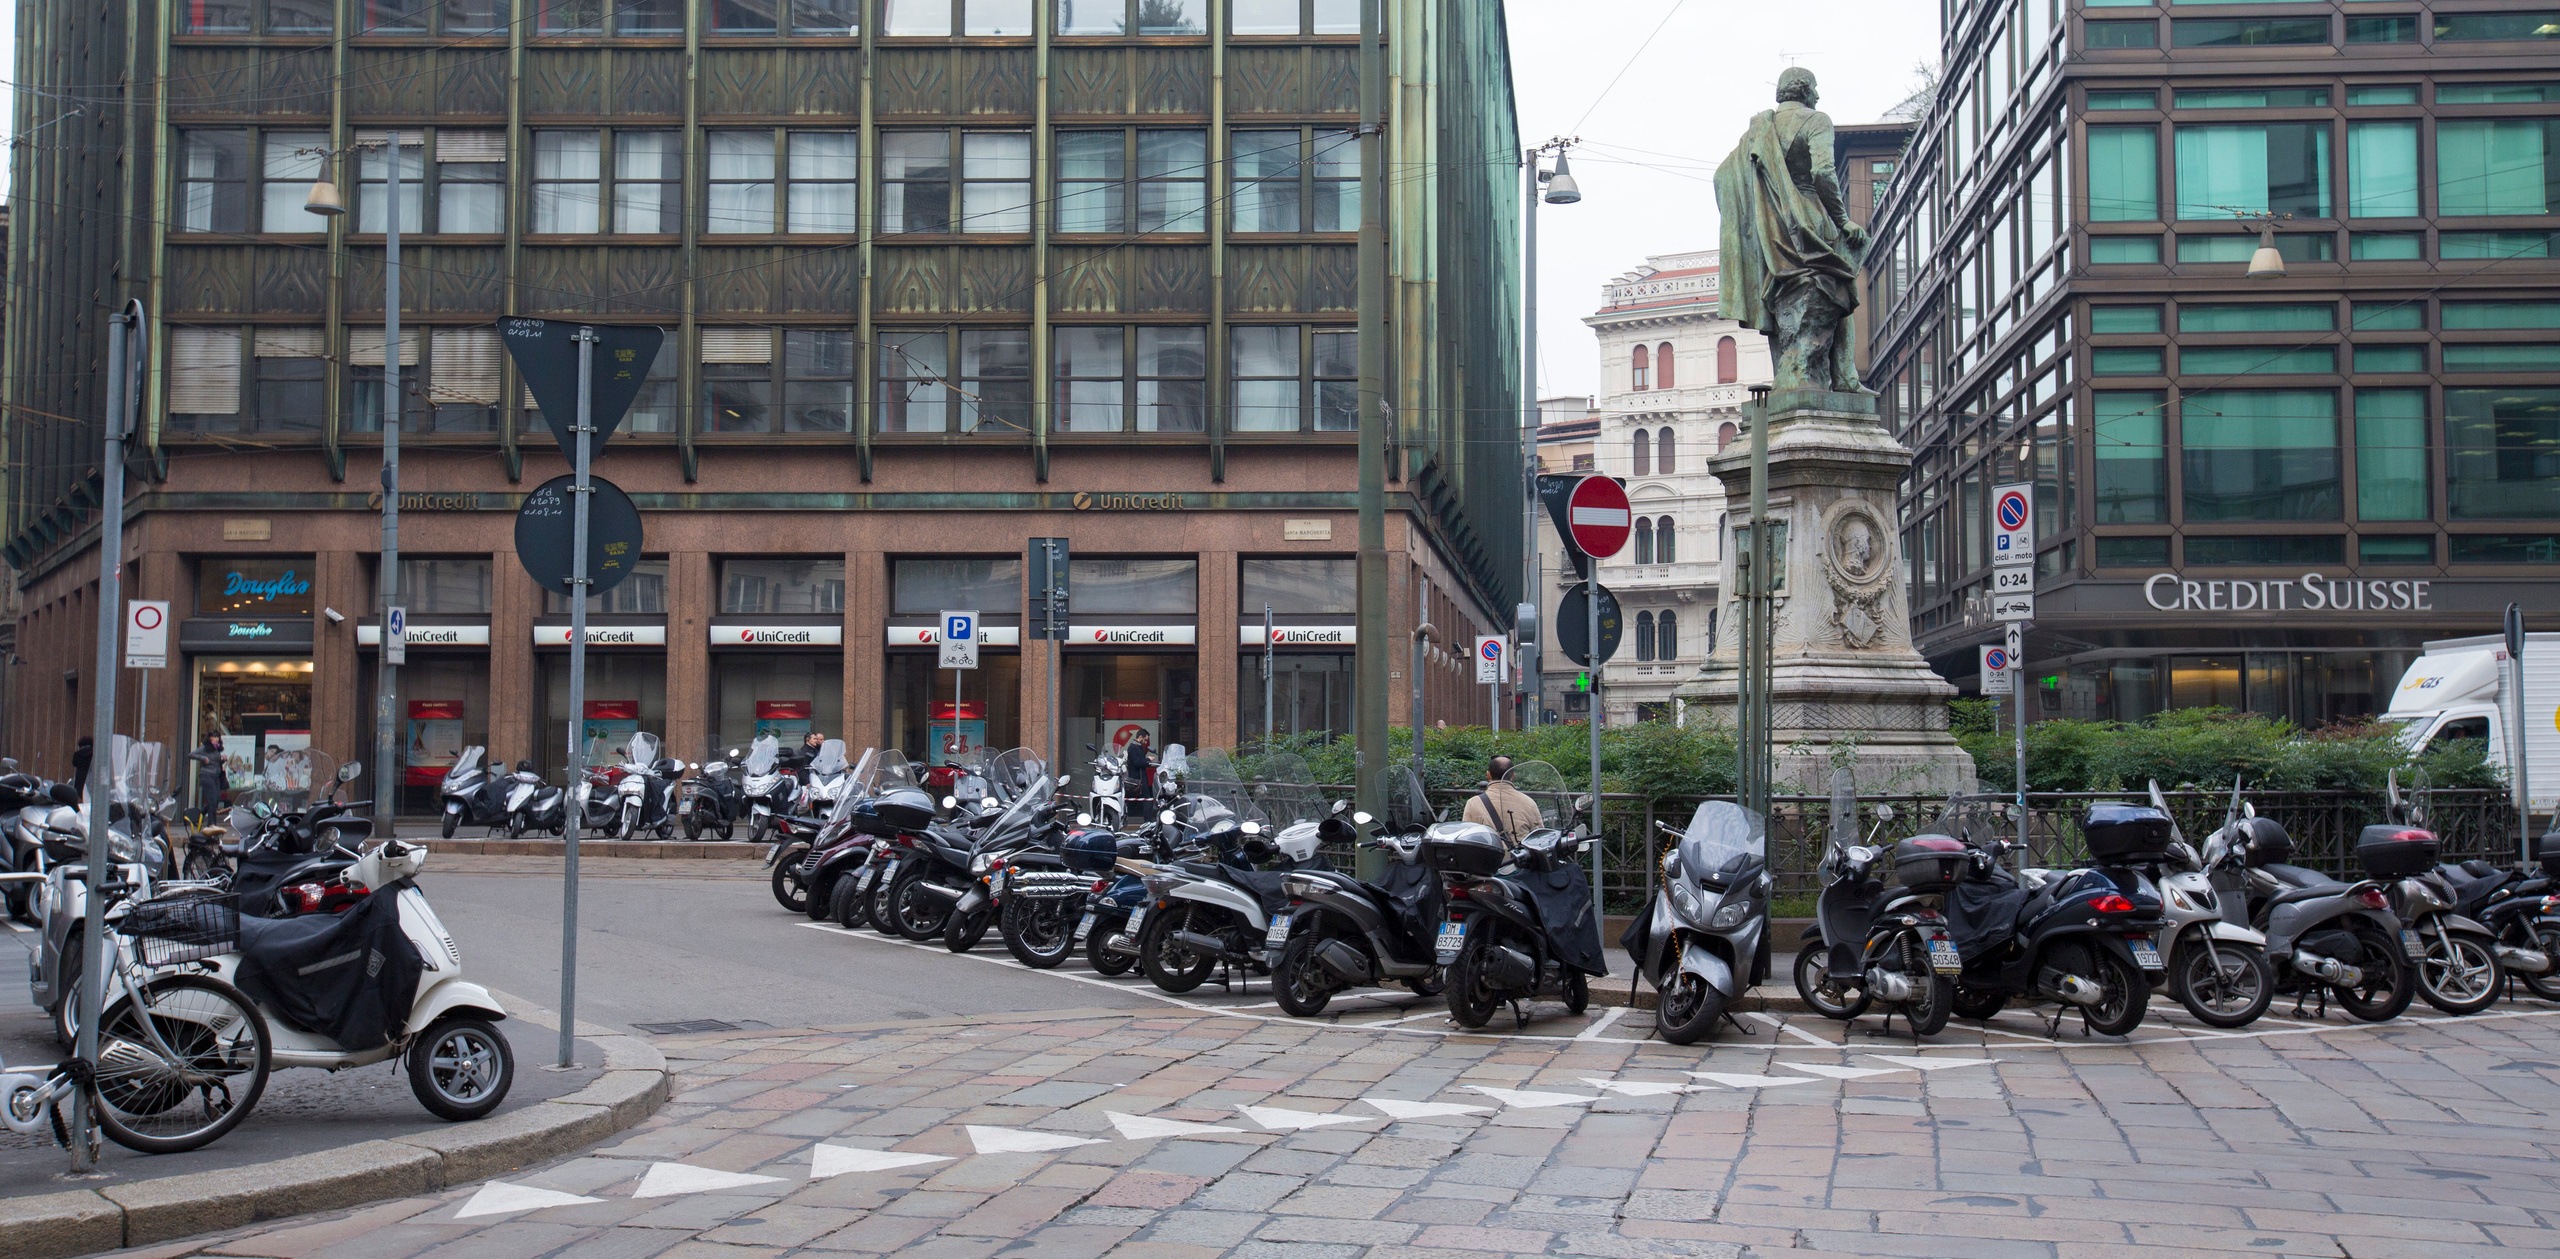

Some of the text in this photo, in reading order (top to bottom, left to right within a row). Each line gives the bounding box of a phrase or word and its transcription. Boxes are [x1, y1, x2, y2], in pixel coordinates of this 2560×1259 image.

[1100, 493, 1184, 509] UniCredit
[1994, 553, 2009, 561] cicli
[2015, 552, 2033, 560] moto
[2000, 573, 2028, 587] 0-24
[224, 570, 310, 602] Douglas
[2143, 572, 2433, 611] CREDIT SUISSE
[228, 622, 273, 639] Douglas
[405, 631, 458, 642] UniCredit
[757, 631, 810, 642] UniCredit
[1111, 631, 1164, 642] UniCredit
[1287, 631, 1342, 642] UniCredit
[2420, 676, 2444, 689] GLS
[1268, 928, 1288, 939] 01694
[1445, 923, 1457, 934] DM
[1437, 936, 1463, 948] 83723
[1934, 941, 1947, 952] DB
[1932, 954, 1960, 966] 50348
[2136, 953, 2161, 964] 19722
